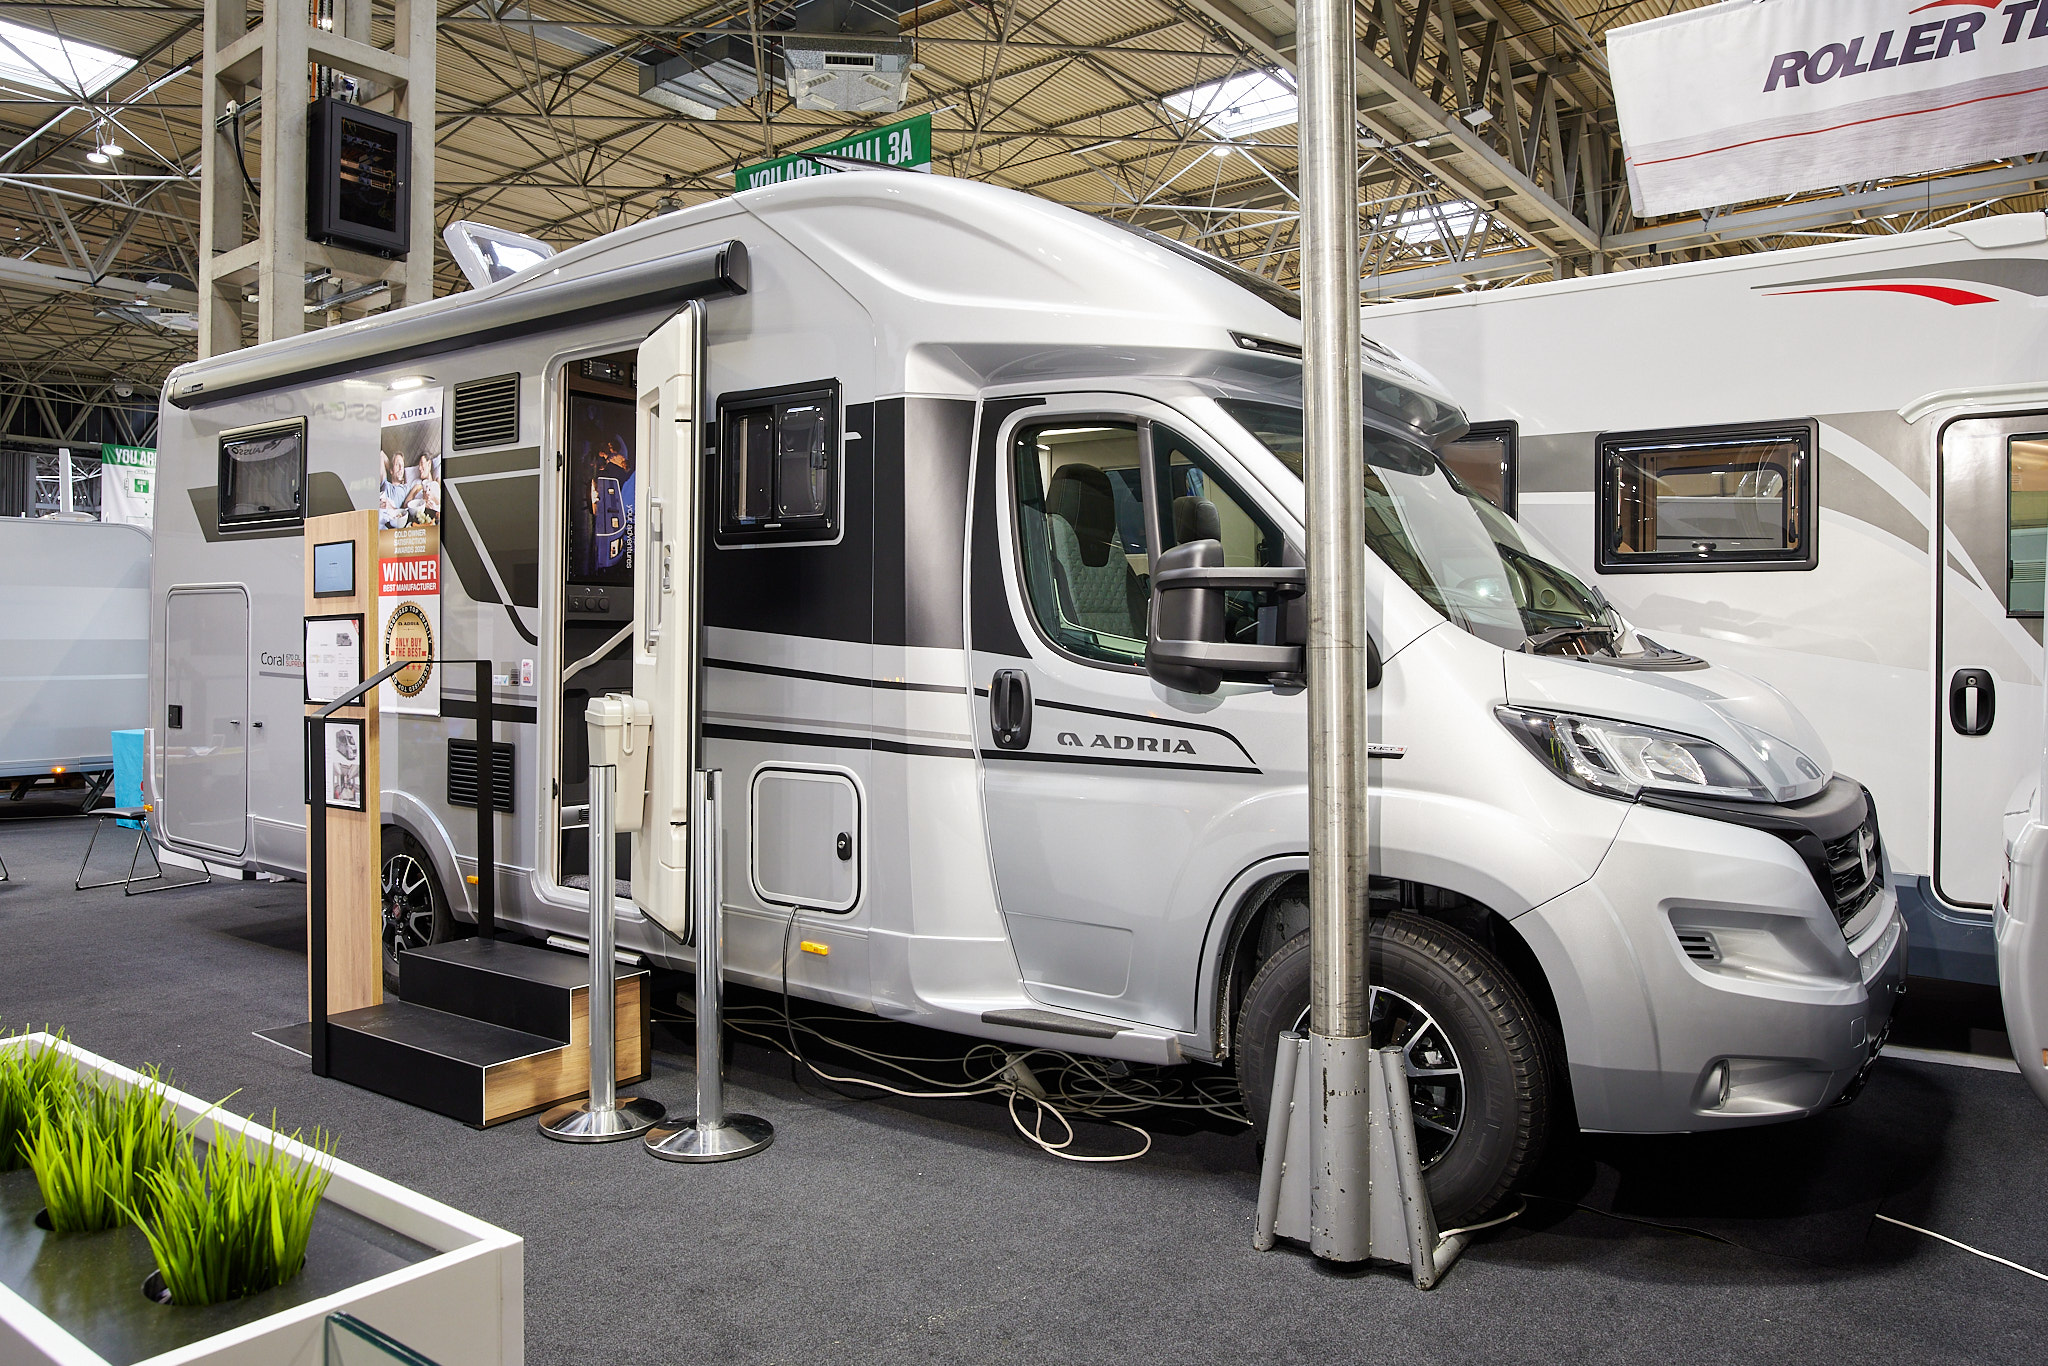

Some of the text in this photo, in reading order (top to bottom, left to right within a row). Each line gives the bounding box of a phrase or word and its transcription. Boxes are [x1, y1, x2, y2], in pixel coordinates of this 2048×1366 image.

[1763, 12, 1986, 92] ROLLER
[888, 128, 912, 165] 3A
[400, 406, 435, 419] ADRIA
[115, 448, 138, 464] YOU
[394, 529, 426, 538] GOLD OWNER
[383, 560, 437, 582] WINNER
[383, 582, 437, 592] BEST MANUFACTURER
[395, 638, 422, 647] ONLY BUY
[261, 652, 284, 667] Coral
[395, 648, 421, 657] THE BEST
[1090, 734, 1197, 754] ADRIA
